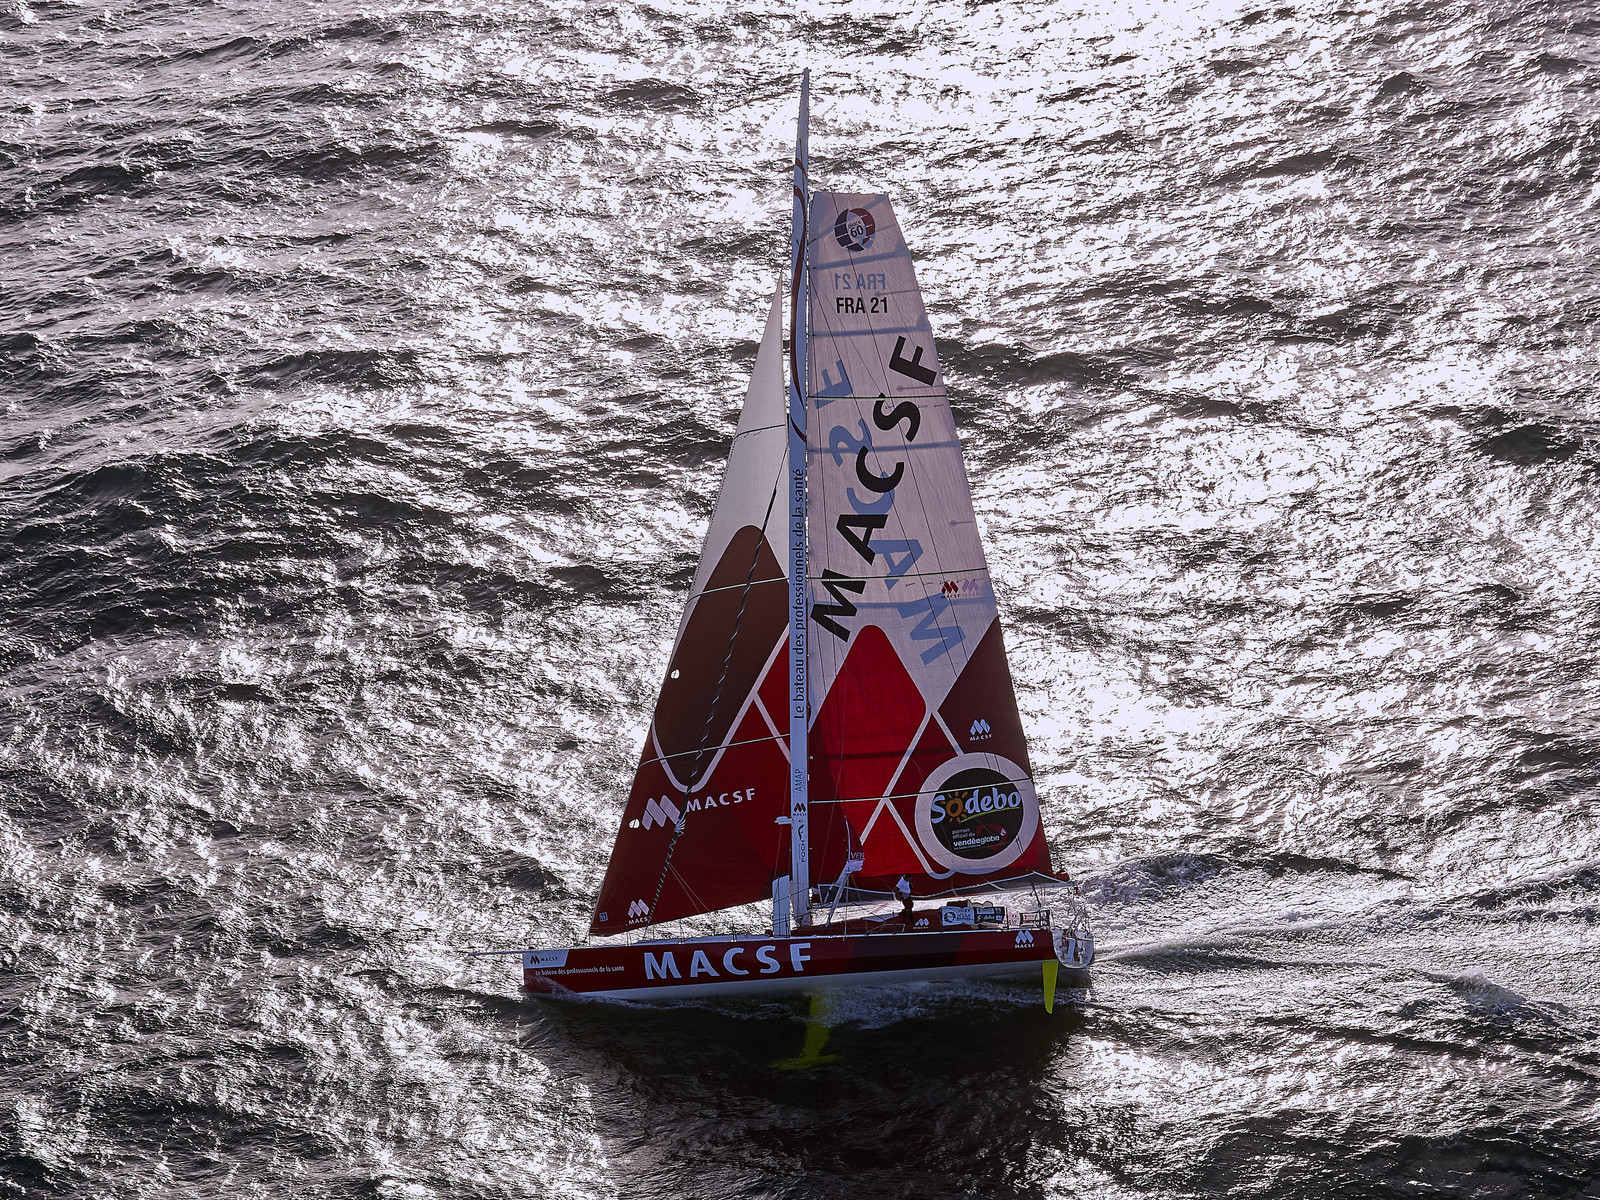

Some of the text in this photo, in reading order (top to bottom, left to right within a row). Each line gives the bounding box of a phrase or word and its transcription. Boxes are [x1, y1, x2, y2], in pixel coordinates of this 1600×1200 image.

[850, 225, 864, 238] 60
[836, 296, 889, 314] FRA 21
[810, 335, 938, 643] MACSF
[791, 468, 806, 719] Le bateau des professionnels de la santé
[969, 733, 993, 742] MACSF
[794, 768, 803, 793] AMAP
[685, 787, 756, 814] MACSF
[628, 916, 651, 925] MACS
[642, 942, 812, 980] MACSF
